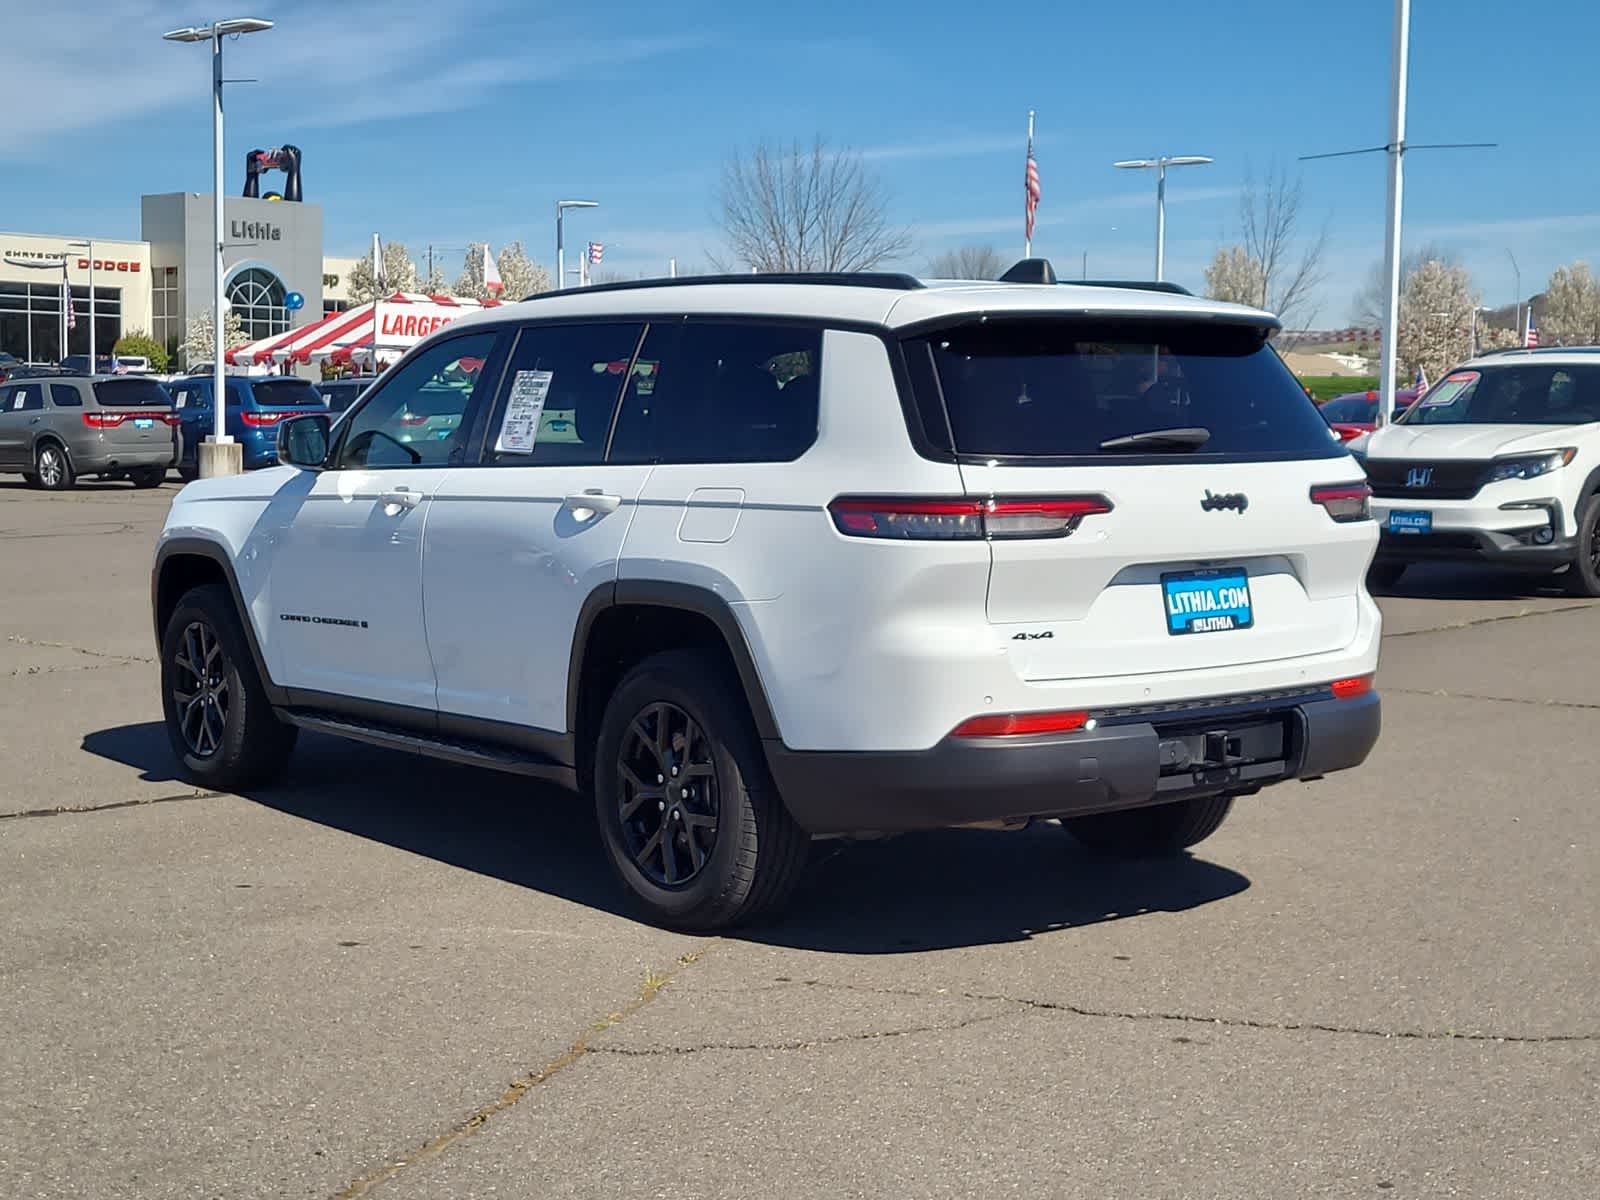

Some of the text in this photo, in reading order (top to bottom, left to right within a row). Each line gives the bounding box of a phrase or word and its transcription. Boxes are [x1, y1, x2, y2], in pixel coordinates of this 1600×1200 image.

[231, 220, 281, 241] Lithia
[78, 259, 141, 272] DODGE
[382, 313, 456, 337] LARGE
[1200, 489, 1249, 515] Jeep
[1168, 587, 1249, 615] LITHIA.COM
[1203, 616, 1234, 632] LITHIA
[1011, 631, 1054, 641] 4x4
